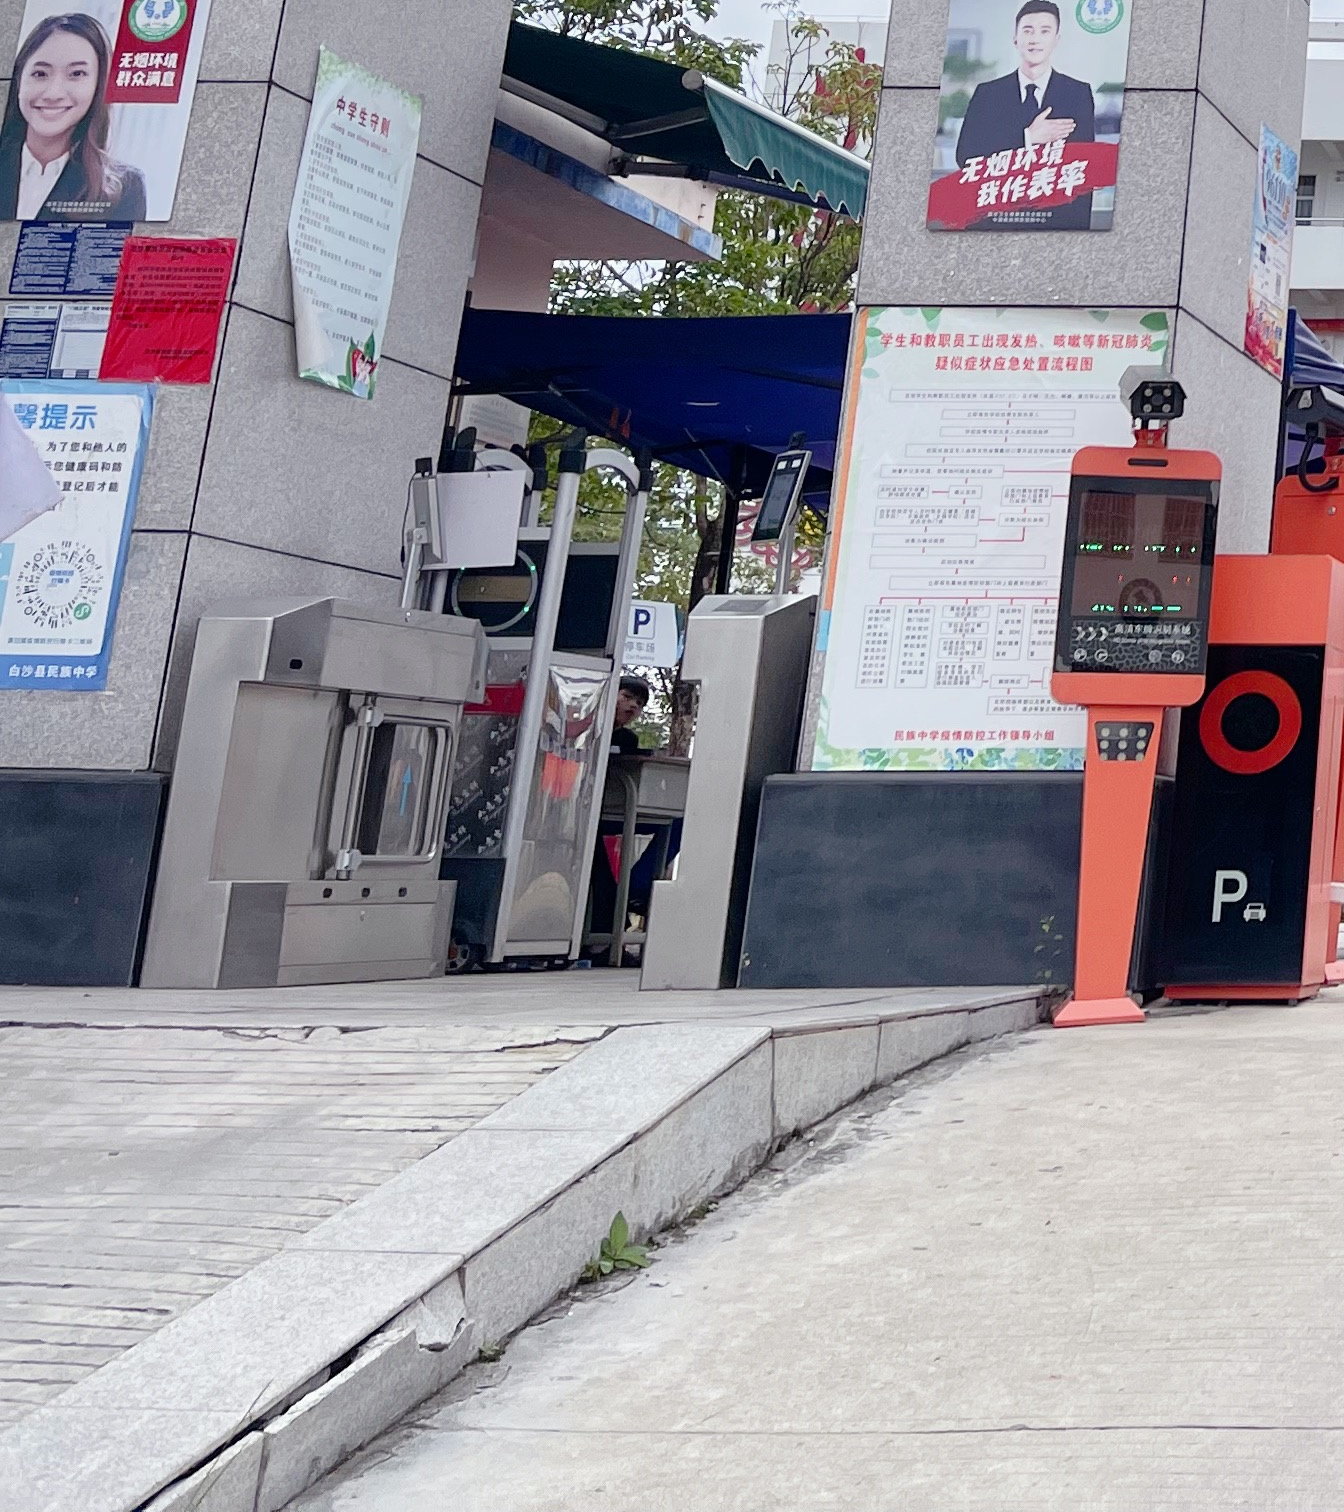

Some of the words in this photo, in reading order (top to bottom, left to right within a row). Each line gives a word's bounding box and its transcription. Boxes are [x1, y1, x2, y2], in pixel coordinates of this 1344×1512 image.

[118, 52, 179, 69] 无烟环境
[115, 71, 176, 87] 群众满意
[336, 95, 391, 138] 中学生守则
[959, 138, 1067, 184] 无烟环境
[977, 159, 1089, 207] 我作表率
[935, 355, 1094, 371] 疑似症状应急处置流程图
[46, 441, 128, 453] 为了您和他人的
[56, 481, 119, 493] 登记后才能
[633, 608, 651, 635] P
[8, 663, 98, 679] 白沙县民族中学
[893, 730, 1056, 742] 民族中学疫情防控工作领导小组
[1212, 869, 1248, 923] P
